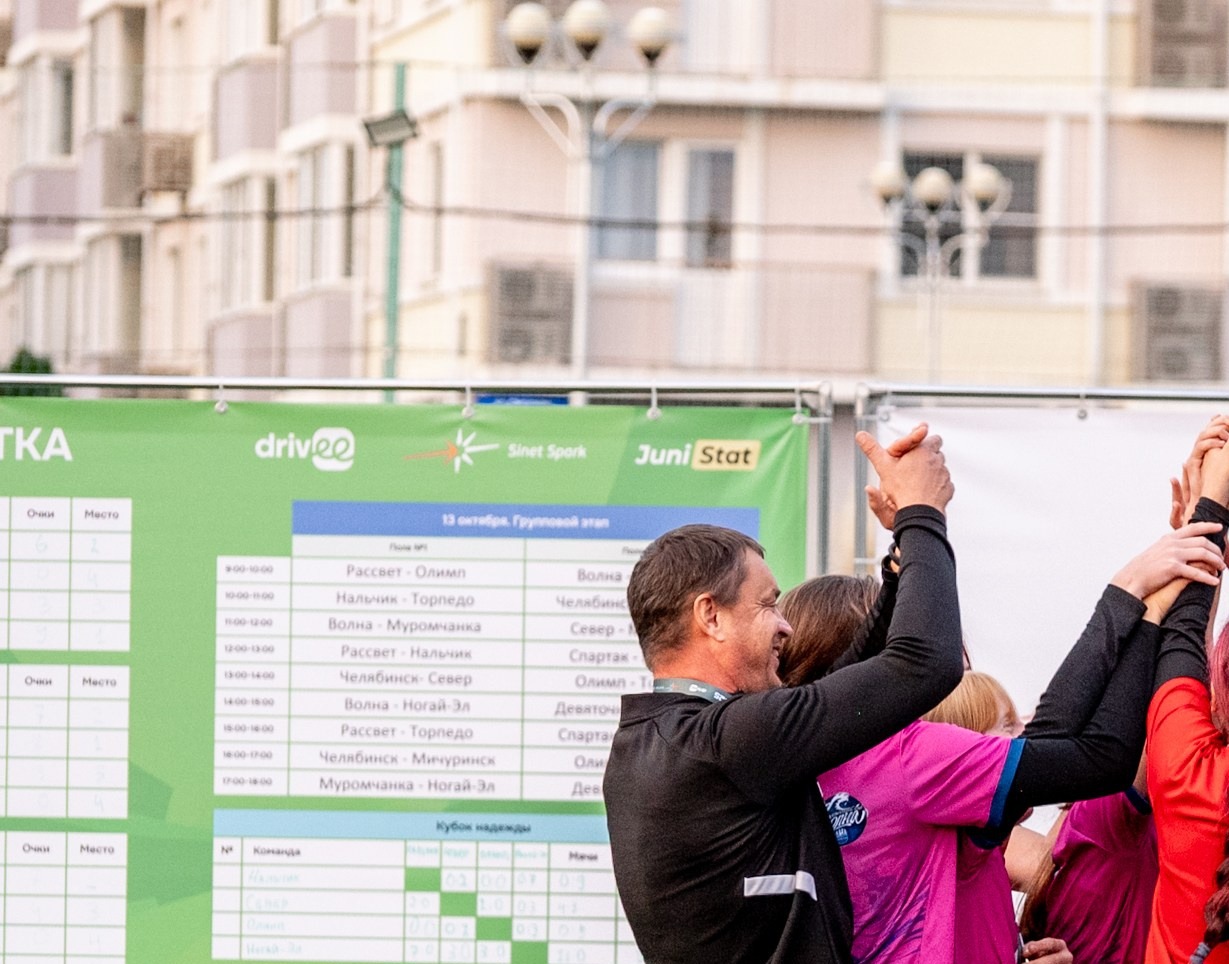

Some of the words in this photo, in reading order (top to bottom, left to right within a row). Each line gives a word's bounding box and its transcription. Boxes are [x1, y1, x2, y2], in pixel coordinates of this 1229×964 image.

[255, 428, 355, 468] drivee
[508, 443, 543, 458] Sinet
[548, 443, 586, 461] Spark
[635, 443, 691, 466] Juni
[698, 445, 752, 465] Stat
[346, 564, 402, 579] Рассвет
[415, 565, 466, 580] Олимп
[577, 568, 622, 583] Волна
[336, 591, 398, 605] Нальчик
[411, 592, 475, 607] Торпедо
[556, 596, 629, 610] Челябинс
[328, 617, 373, 631] Волна
[387, 618, 482, 634] Муромчанка
[570, 622, 615, 637] Север
[341, 645, 396, 658] Рассвет
[410, 646, 472, 659] Нальчик
[569, 649, 629, 664] Спартак
[428, 672, 473, 687] Север
[575, 675, 626, 690] Олимп
[344, 698, 389, 712] Волна
[402, 698, 471, 713] Ногай-Эл
[341, 724, 396, 737] Рассвет
[409, 725, 474, 740] Торпедо
[319, 751, 398, 764] Челябинск
[412, 752, 496, 767] Мичуринск
[319, 777, 414, 792] Муромчанка
[427, 777, 496, 793] Ногай-Эл
[436, 820, 473, 834] Кубок
